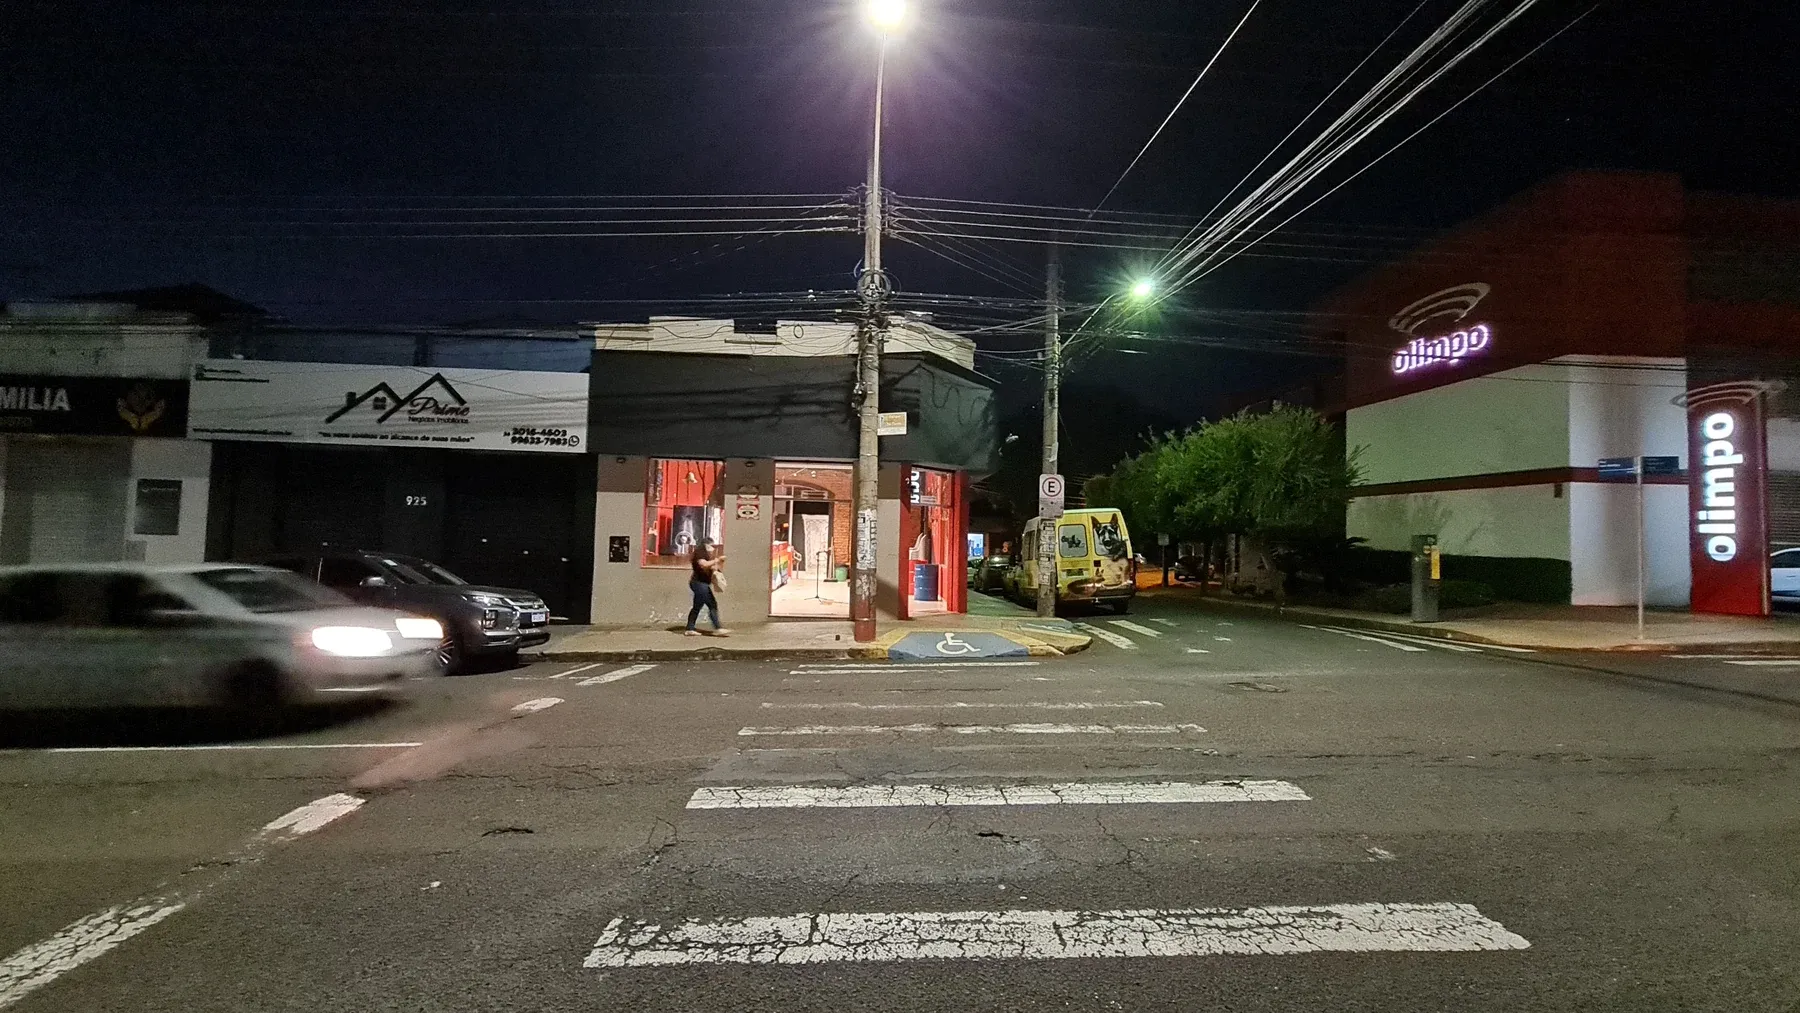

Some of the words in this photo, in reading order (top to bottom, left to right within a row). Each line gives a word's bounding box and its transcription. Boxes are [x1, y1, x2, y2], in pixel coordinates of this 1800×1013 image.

[1392, 325, 1489, 373] olimpo
[407, 397, 470, 416] Prime
[1048, 481, 1055, 493] E
[1698, 412, 1743, 562] olimpo
[406, 495, 427, 506] 925
